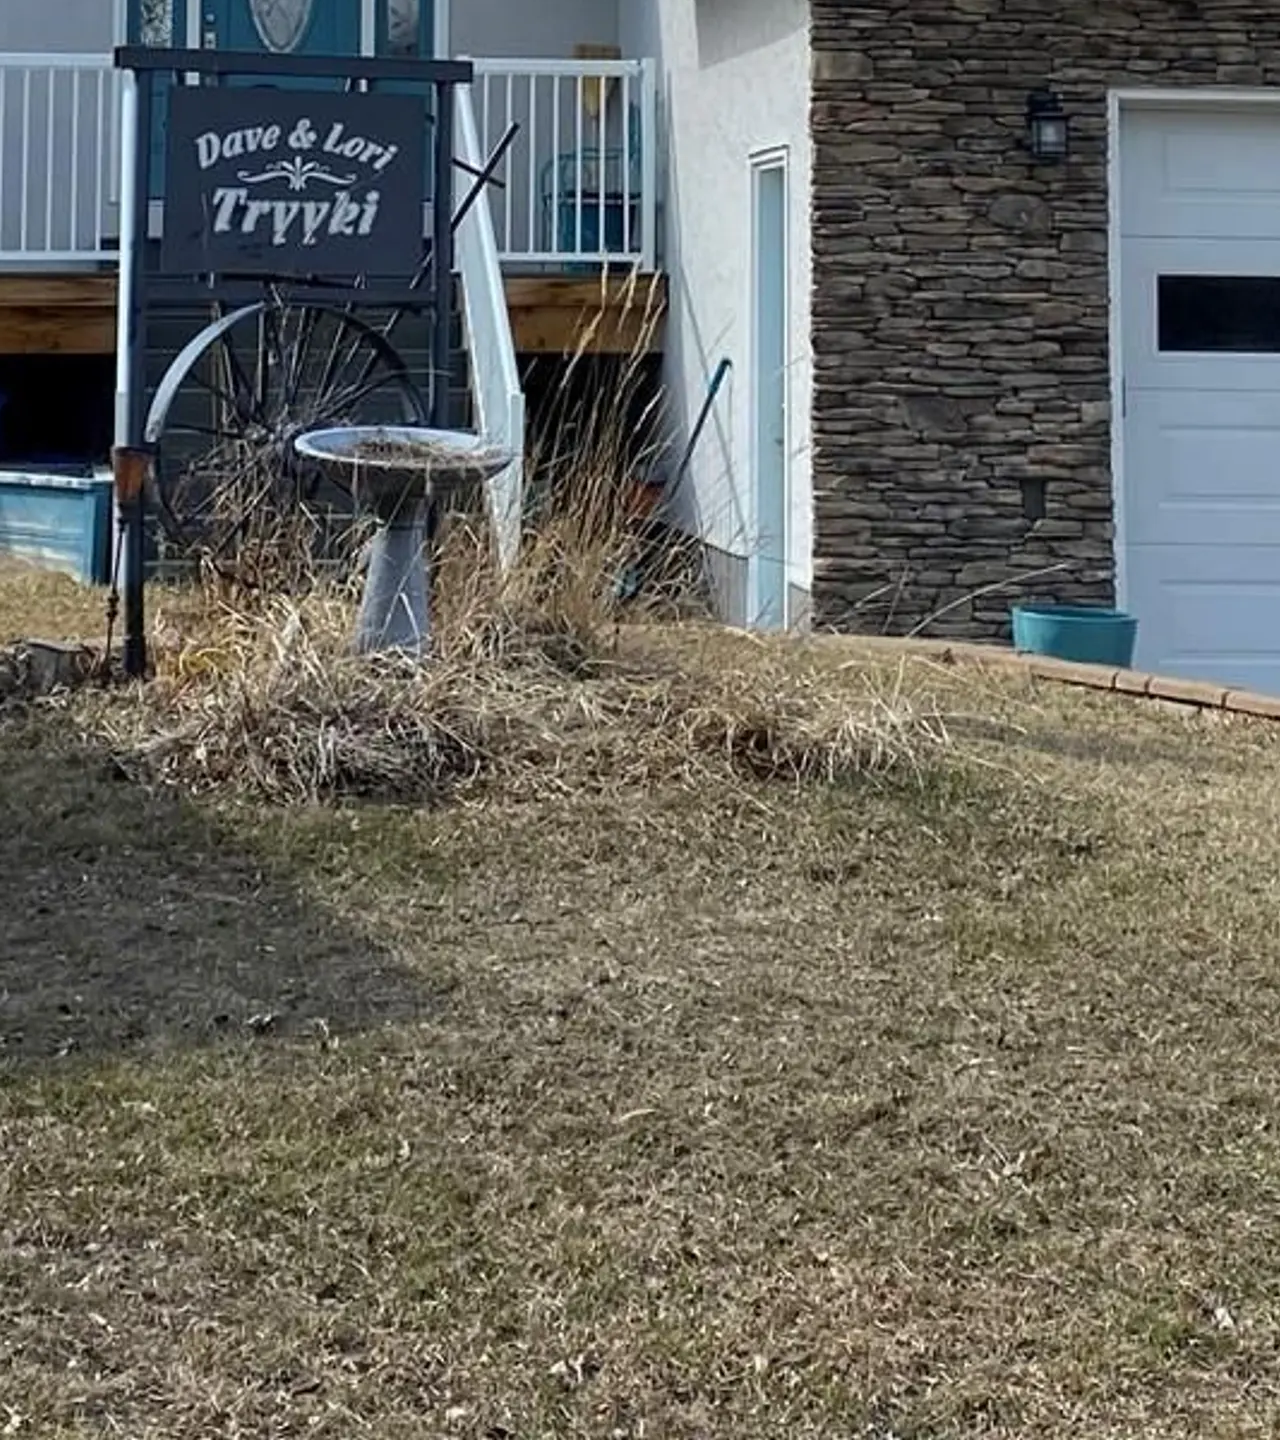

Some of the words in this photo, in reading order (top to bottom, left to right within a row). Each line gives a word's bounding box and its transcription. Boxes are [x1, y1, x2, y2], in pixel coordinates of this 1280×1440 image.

[194, 122, 282, 169] Dave
[288, 117, 317, 150] &
[323, 122, 399, 169] Lori
[212, 186, 380, 246] Tryyki
